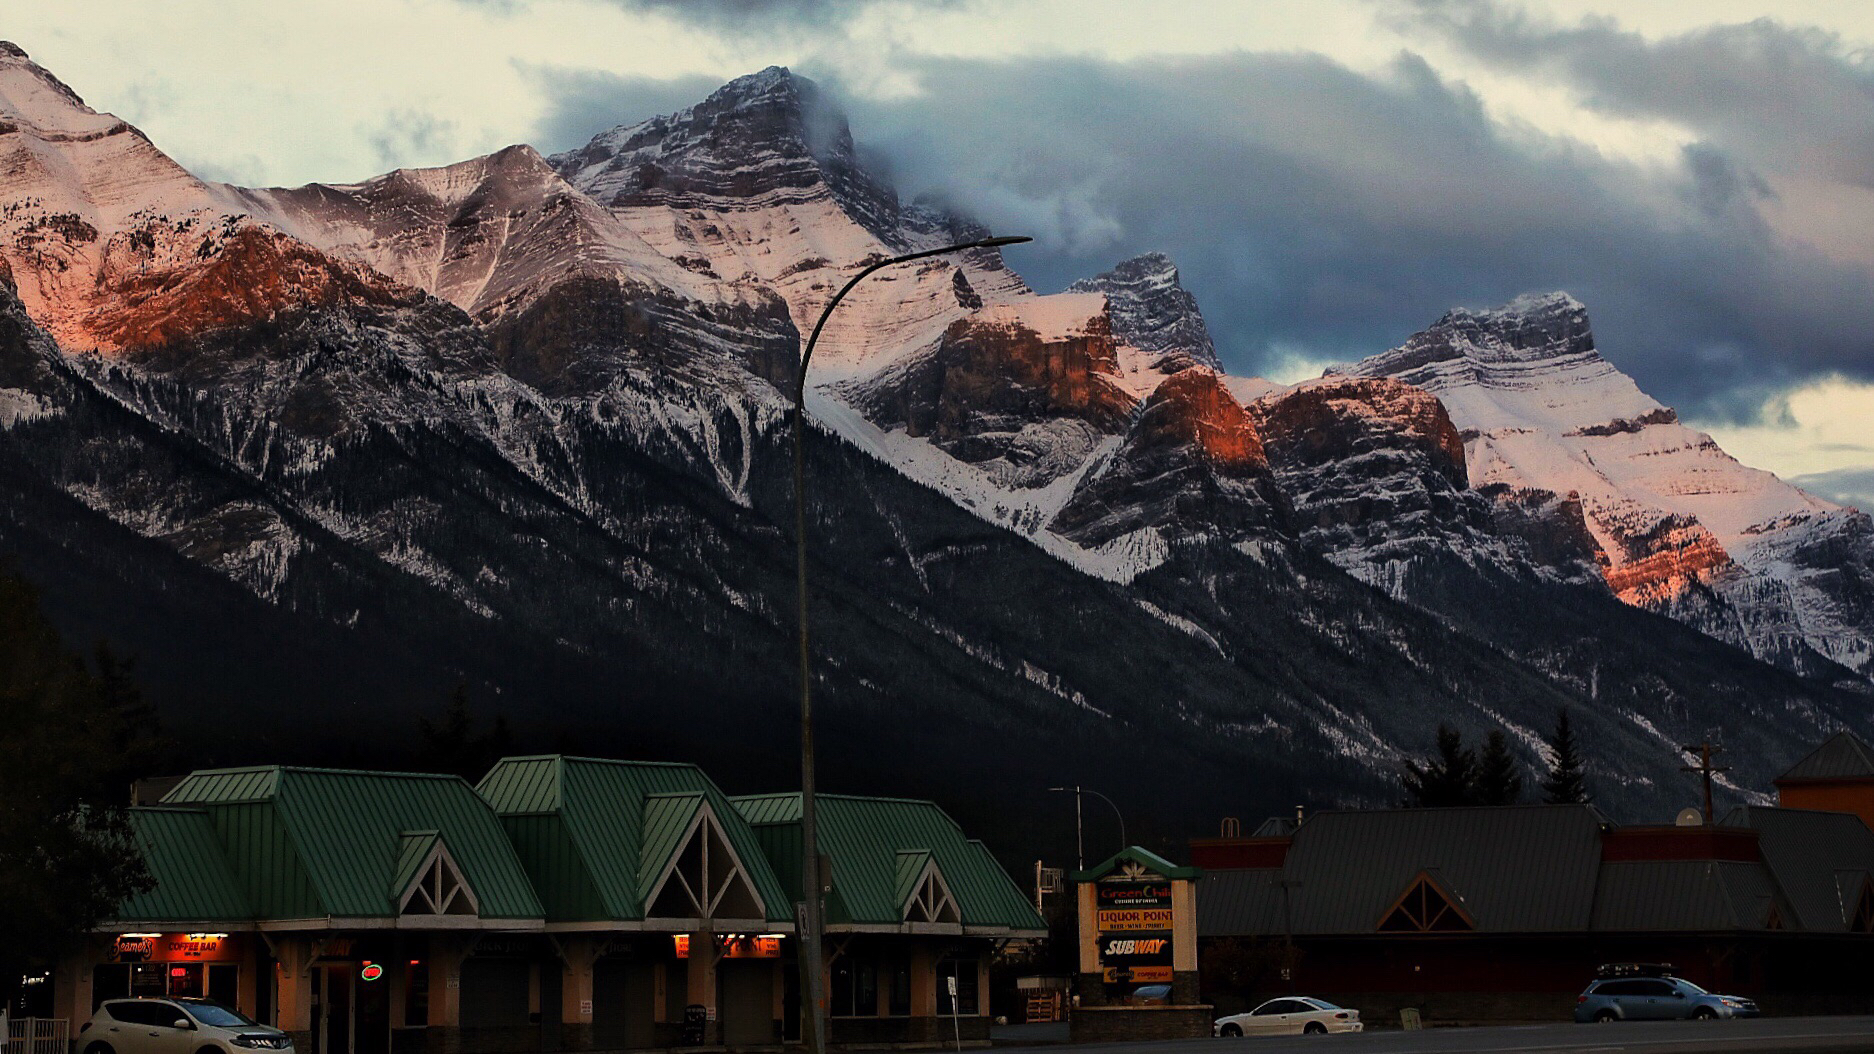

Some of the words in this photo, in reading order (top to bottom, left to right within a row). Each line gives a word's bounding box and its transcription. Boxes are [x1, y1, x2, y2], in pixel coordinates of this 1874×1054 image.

[1101, 912, 1140, 922] LIQUOR
[1144, 912, 1172, 921] POINT
[168, 942, 199, 951] COFFEE
[200, 942, 217, 951] BAR
[1105, 939, 1167, 955] SUBWAY
